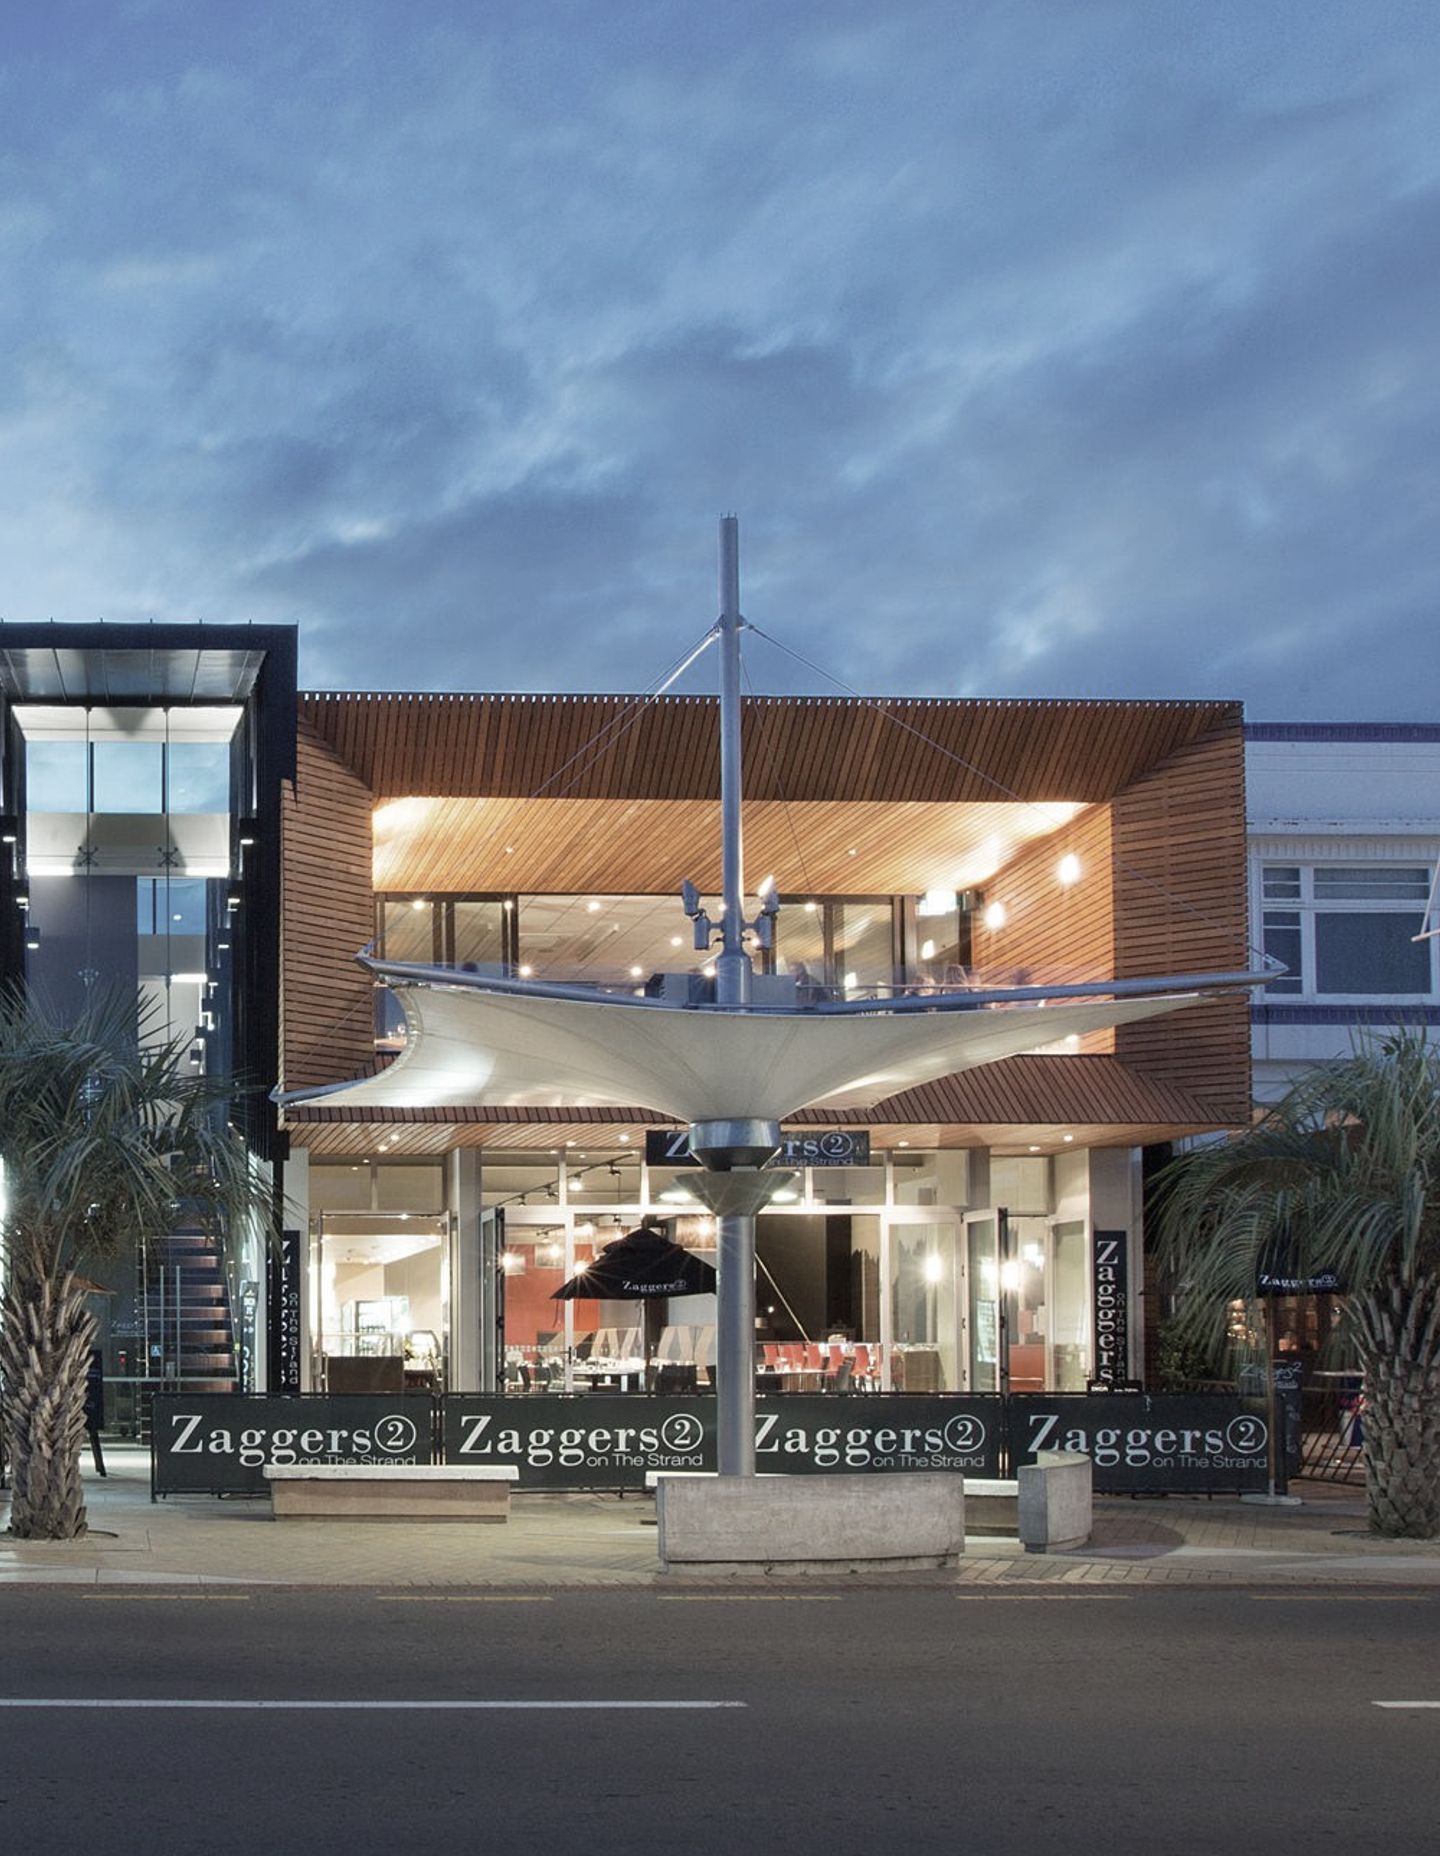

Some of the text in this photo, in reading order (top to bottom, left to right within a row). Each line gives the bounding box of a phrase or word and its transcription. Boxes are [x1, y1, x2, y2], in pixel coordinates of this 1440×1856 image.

[289, 1336, 299, 1385] Strand
[361, 1455, 417, 1466] Strand
[586, 1453, 703, 1467] on The Strand
[872, 1454, 985, 1467] on The Strand
[1152, 1455, 1268, 1469] on The Strand
